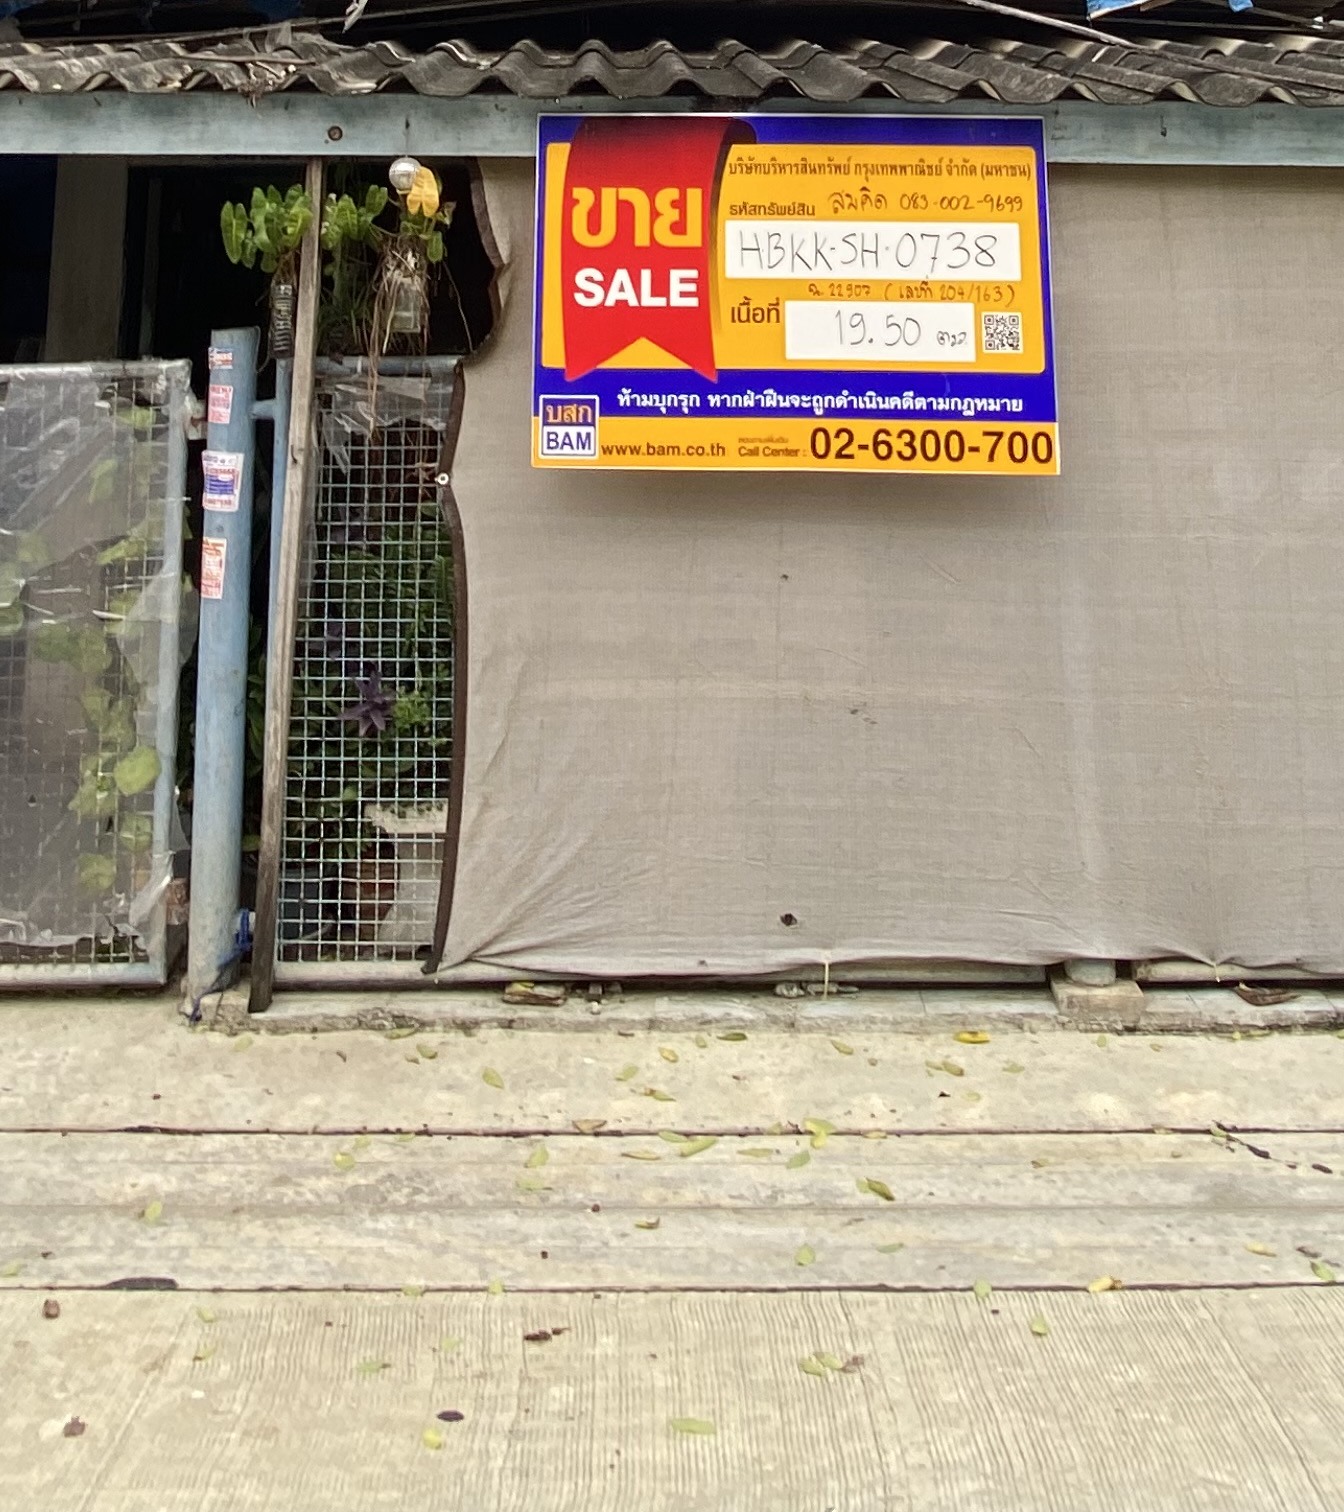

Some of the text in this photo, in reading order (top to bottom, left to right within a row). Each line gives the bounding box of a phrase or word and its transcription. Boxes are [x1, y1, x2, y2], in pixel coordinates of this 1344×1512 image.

[729, 156, 1031, 182] บริษัทบริหารสินทรัพย์ กรุงเทพพาณิชย์ จำกัด (มหาชน)
[572, 187, 703, 248] ขาย
[729, 200, 816, 217] รหัสทรัพย์สิน
[573, 267, 700, 308] SALE
[730, 297, 781, 325] เนื้อที่
[834, 309, 922, 347] 19.50
[545, 403, 592, 424] บสก
[617, 387, 1023, 416] ห้ามบุกรุก หากฝ่าฝืนจะถูกดำเนินคดีตามกฎหมาย
[546, 431, 592, 451] BAM
[601, 441, 726, 458] www.bam.co.th
[738, 445, 760, 457] Call
[810, 426, 1054, 465] 02-6300-700
